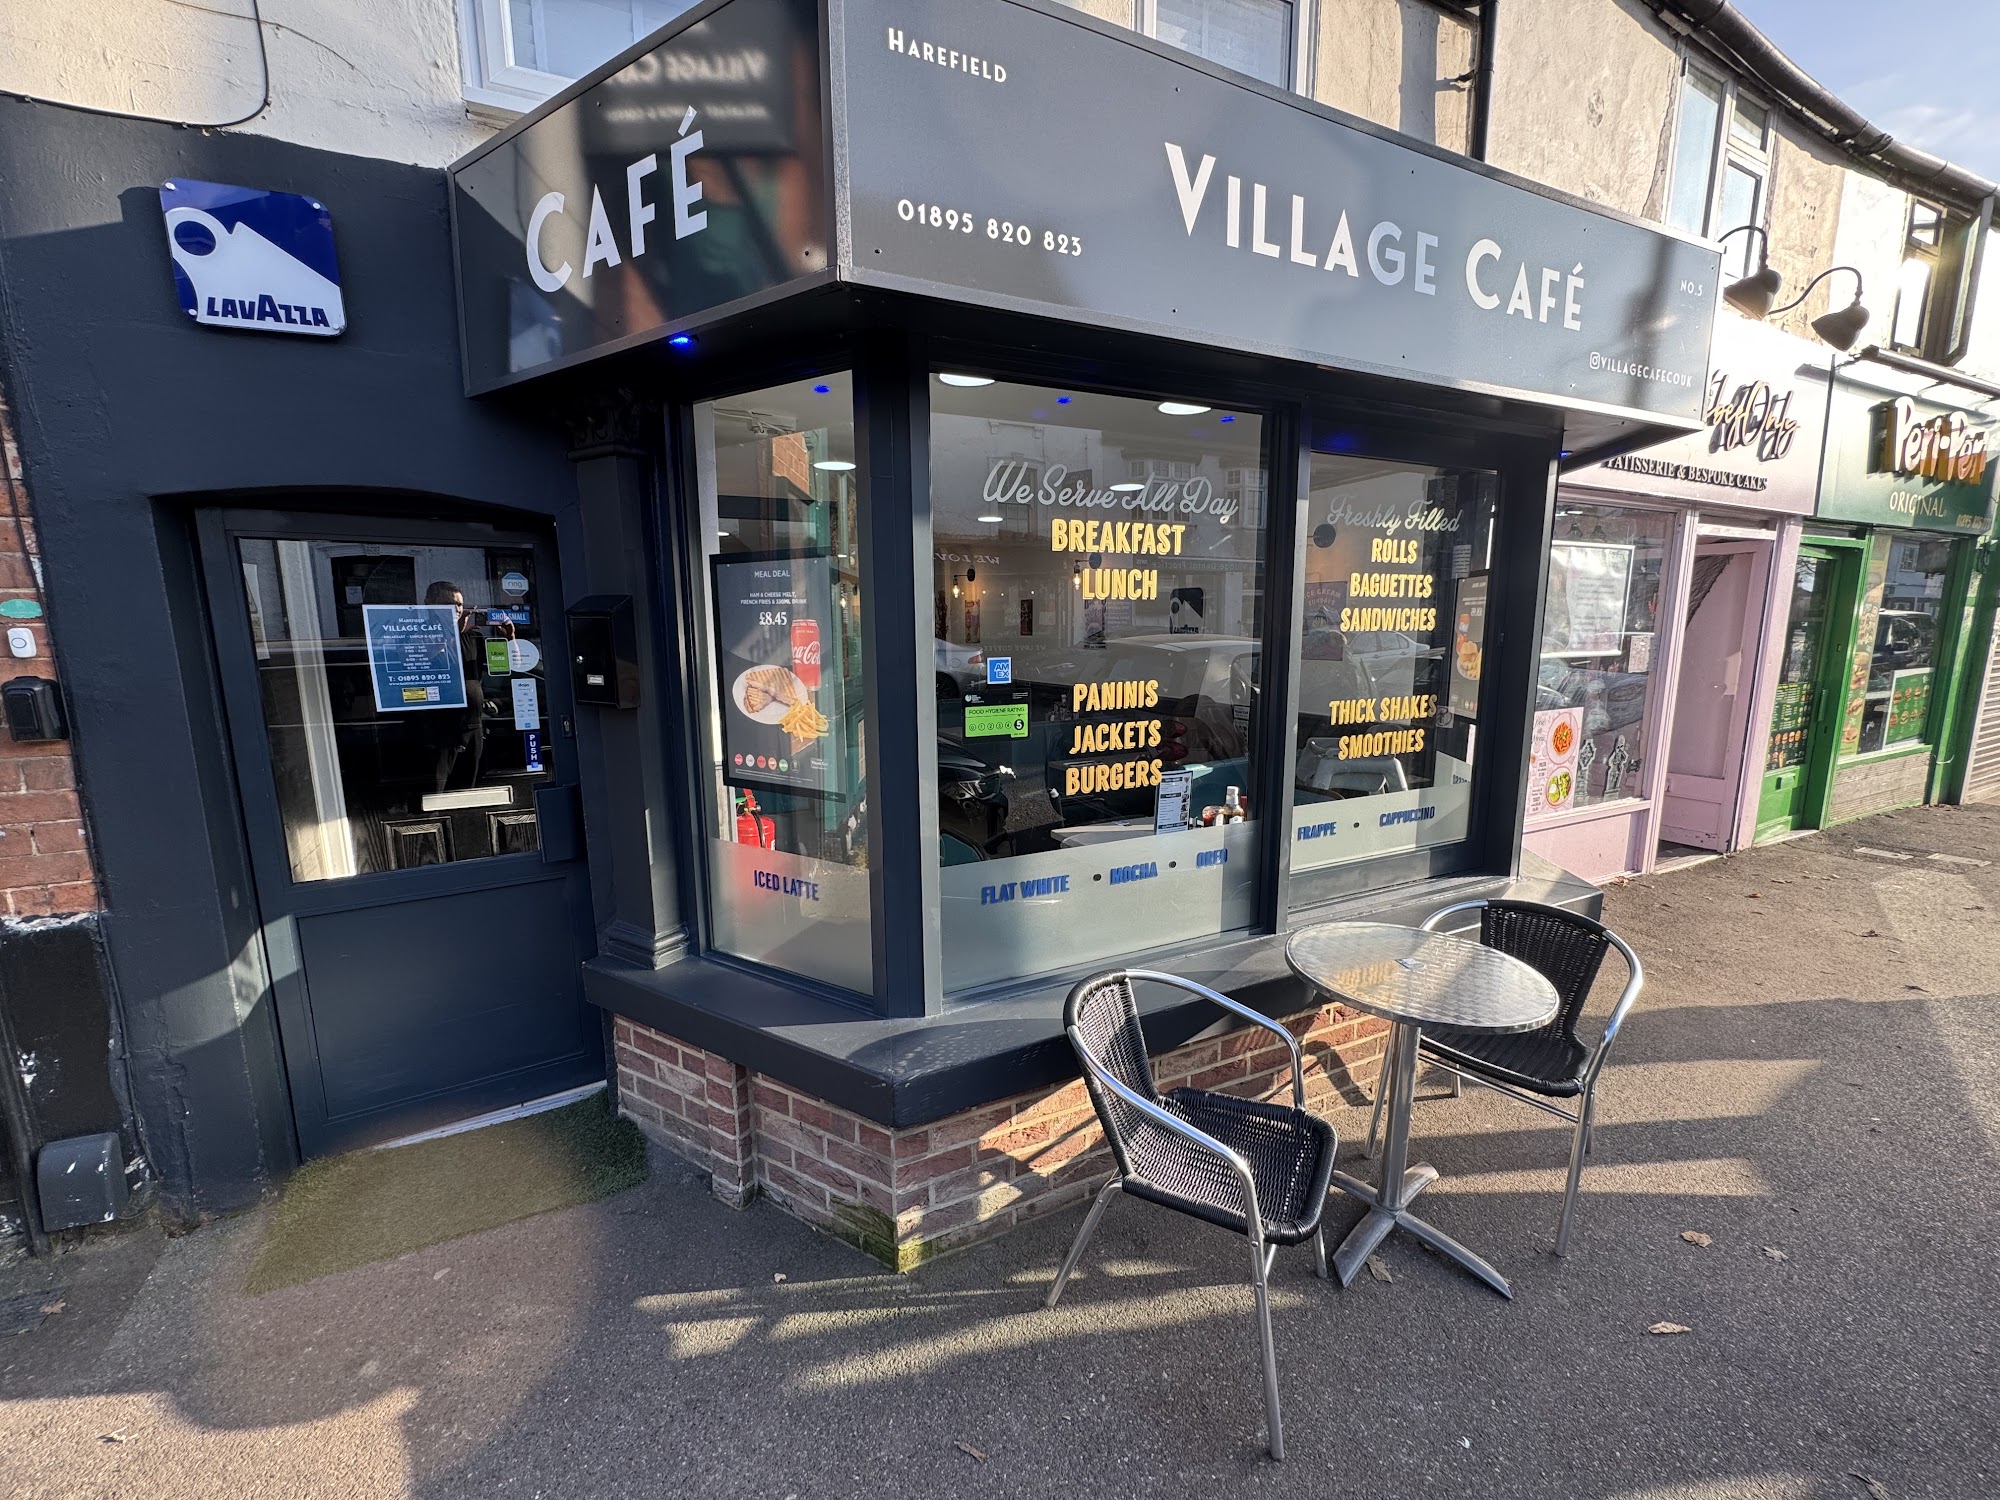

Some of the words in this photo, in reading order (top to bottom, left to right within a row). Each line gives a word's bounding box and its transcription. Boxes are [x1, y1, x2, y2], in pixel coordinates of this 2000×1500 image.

[888, 27, 1007, 83] HAREFIELD
[527, 105, 708, 293] CAFÉ
[898, 199, 974, 233] 01895
[987, 218, 1032, 246] 820
[1044, 231, 1082, 257] 823
[1165, 142, 1439, 296] VILLAGE
[1464, 238, 1585, 332] CAFÉ
[1680, 280, 1703, 296] NO.5
[206, 294, 330, 328] LAVAZZA
[983, 460, 1034, 505] We
[1038, 464, 1117, 508] Serve
[1121, 473, 1179, 512] All
[1179, 477, 1238, 524] Day
[1677, 464, 1687, 480] &
[1688, 465, 1735, 488] BESPOKE
[1736, 473, 1768, 492] CAKES
[1326, 496, 1401, 535] Freshly
[1404, 500, 1463, 532] Filled
[1890, 491, 1944, 517] ORIGINAL
[1051, 518, 1186, 556] BREAKFAST
[1371, 538, 1418, 564] ROLLS
[508, 581, 522, 589] ring
[754, 570, 771, 578] MEAL
[1082, 568, 1158, 600] LUNCH
[1350, 572, 1433, 598] BAGUETTES
[382, 624, 418, 632] VILLAGE
[421, 623, 442, 631] CAFÉ
[508, 612, 526, 621] SMALL
[759, 611, 787, 626] £8.45
[1340, 607, 1436, 632] SANDWICHES
[1073, 679, 1159, 712] PANINIS
[1329, 698, 1376, 725] THICK
[1380, 694, 1438, 721] SHAKES
[529, 734, 537, 760] PUSH
[1069, 719, 1161, 754] JACKETS
[1338, 728, 1425, 760] SMOOTHIES
[1066, 758, 1163, 796] BURGERS
[1297, 821, 1337, 841] FRAPPE
[1379, 806, 1435, 827] CAPPUCCINO
[754, 870, 780, 891] ICED
[783, 877, 819, 901] LATTE
[981, 882, 1017, 905] FLAT
[1020, 874, 1070, 899] WHITE
[1110, 862, 1158, 885] MOCHA
